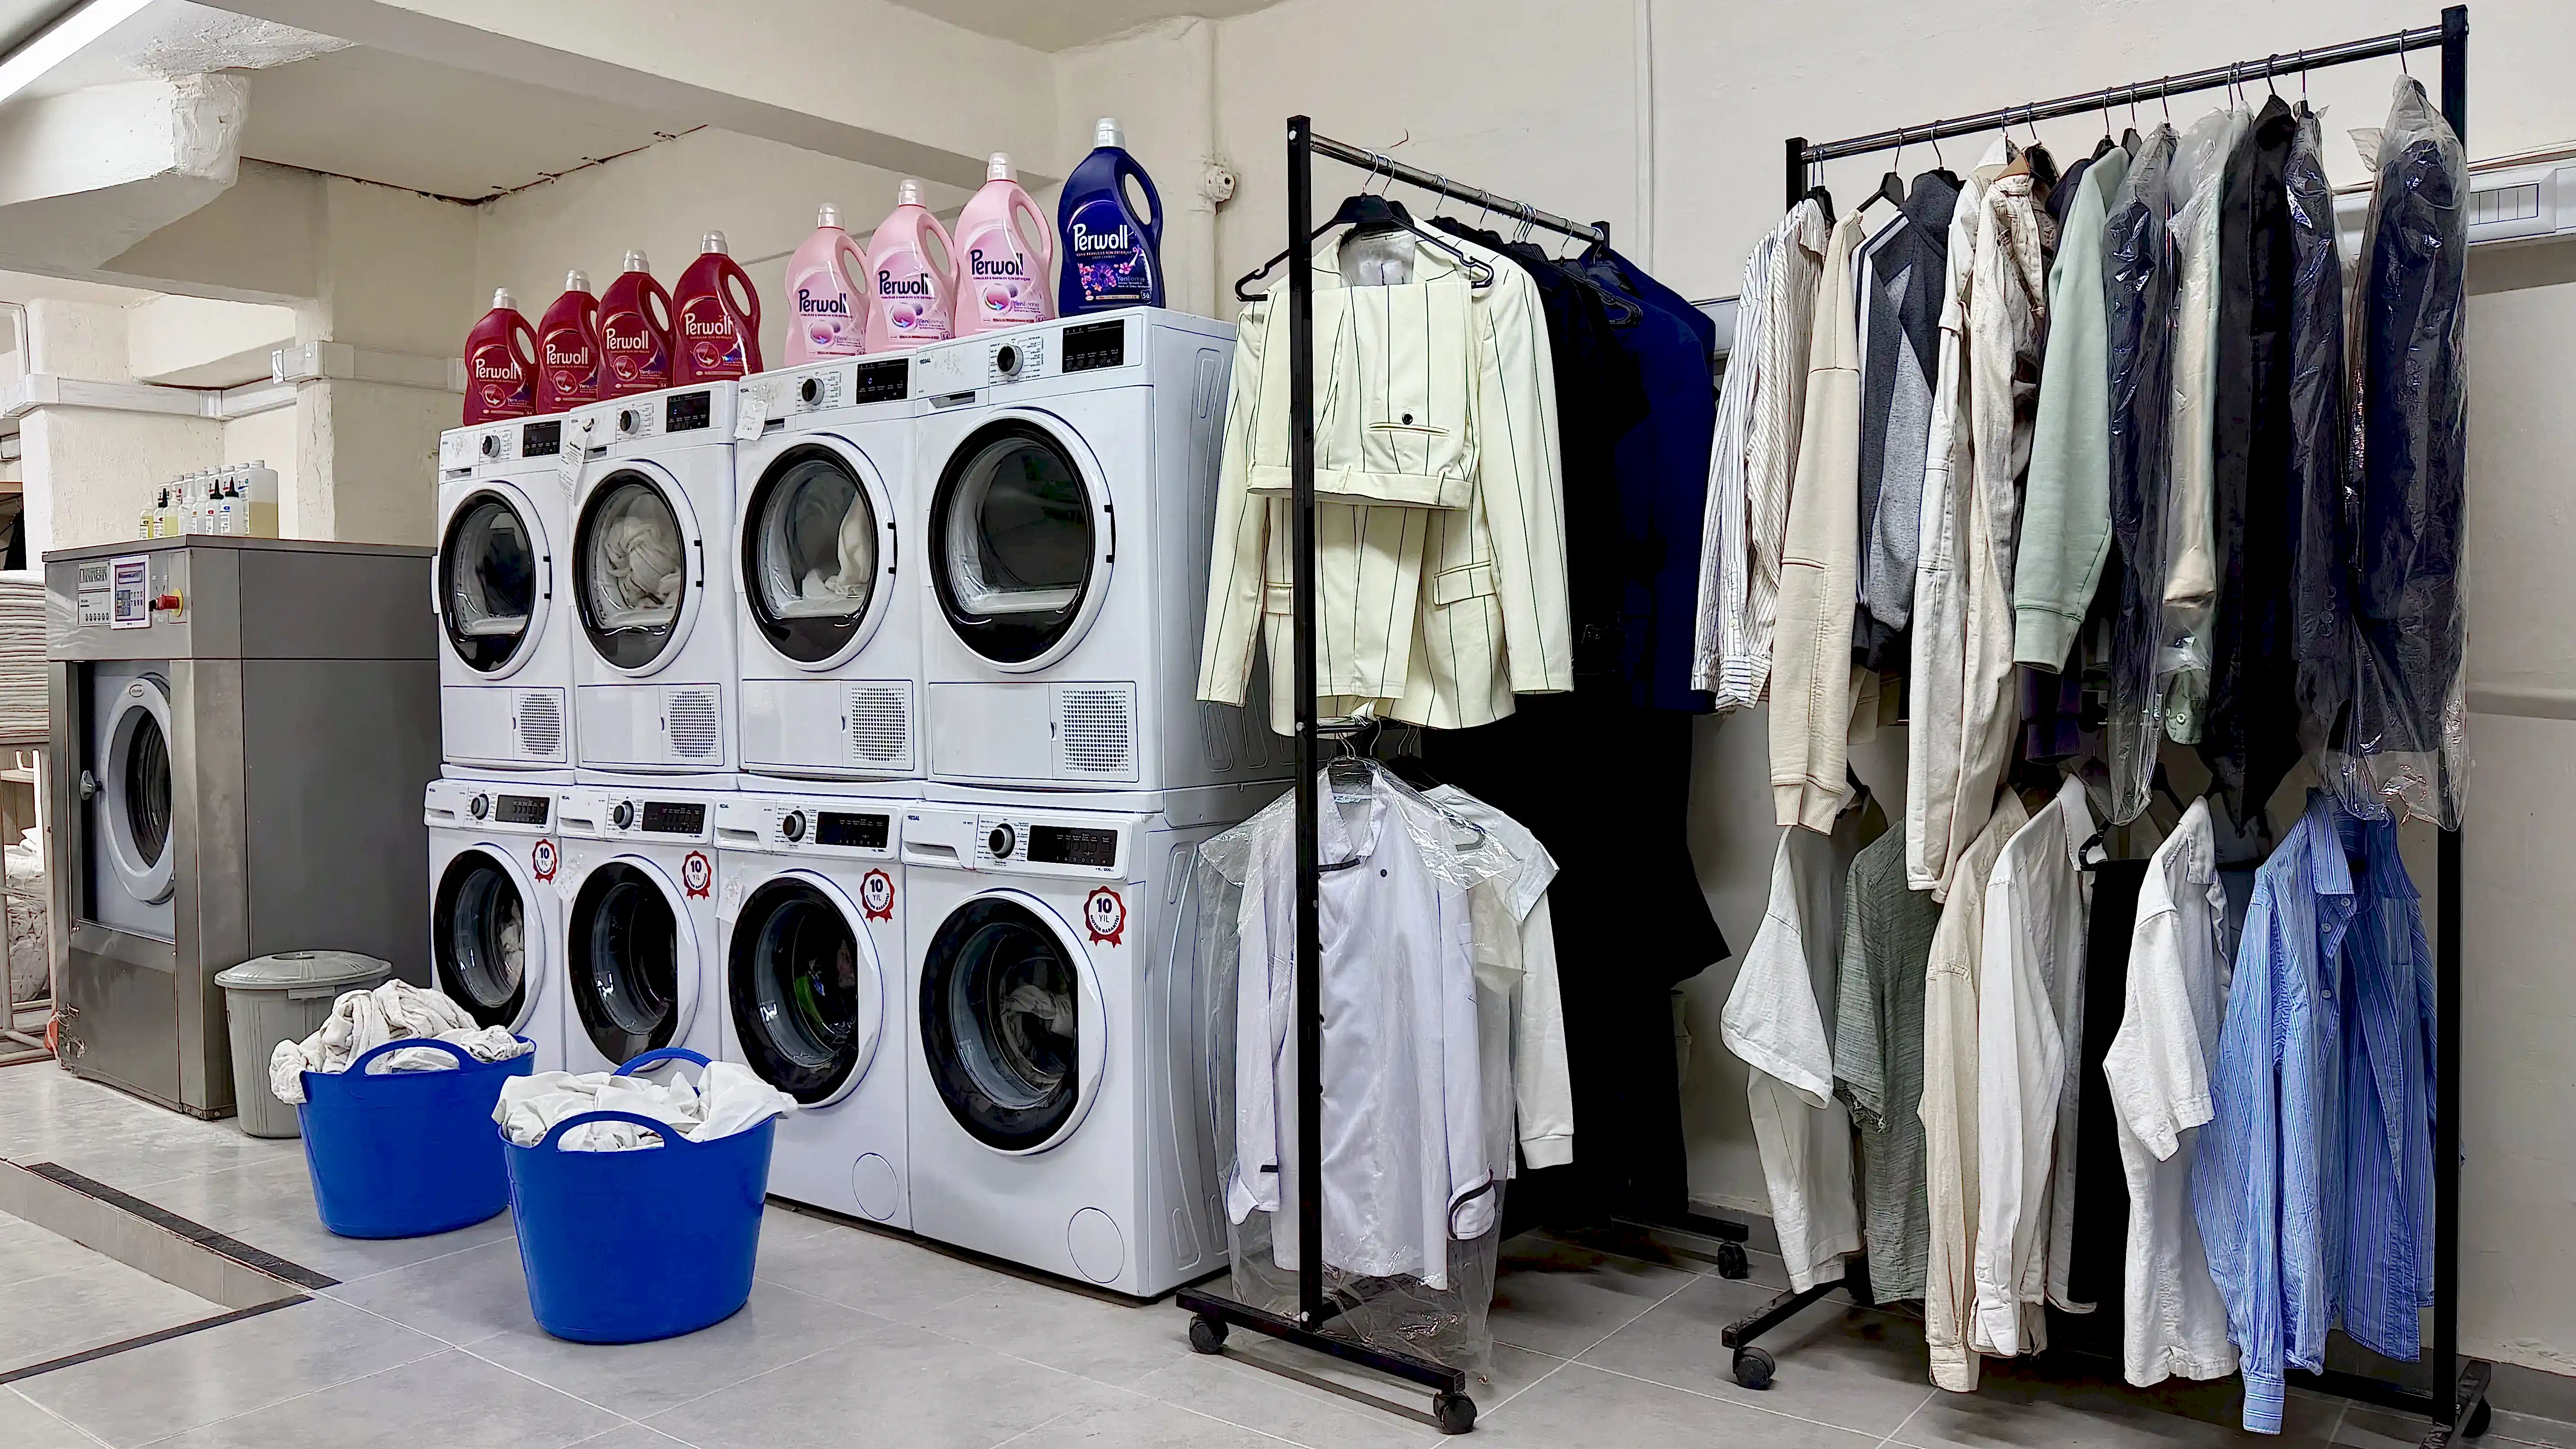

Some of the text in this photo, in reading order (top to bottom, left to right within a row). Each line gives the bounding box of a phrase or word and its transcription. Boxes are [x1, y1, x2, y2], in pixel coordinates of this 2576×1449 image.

[1073, 224, 1128, 251] Perwoll
[971, 249, 1023, 276] Perwoll
[879, 270, 928, 294] Perwoll
[798, 289, 846, 313] Perwoll
[685, 313, 731, 335] Perwoll
[606, 328, 649, 350] Perwoll
[546, 344, 588, 364] Perwoll
[475, 359, 517, 379] Perwoll
[540, 847, 550, 859] 10
[690, 860, 702, 873] 10
[870, 879, 883, 892] 10
[1096, 897, 1112, 913] 10
[1099, 914, 1109, 923] YIL
